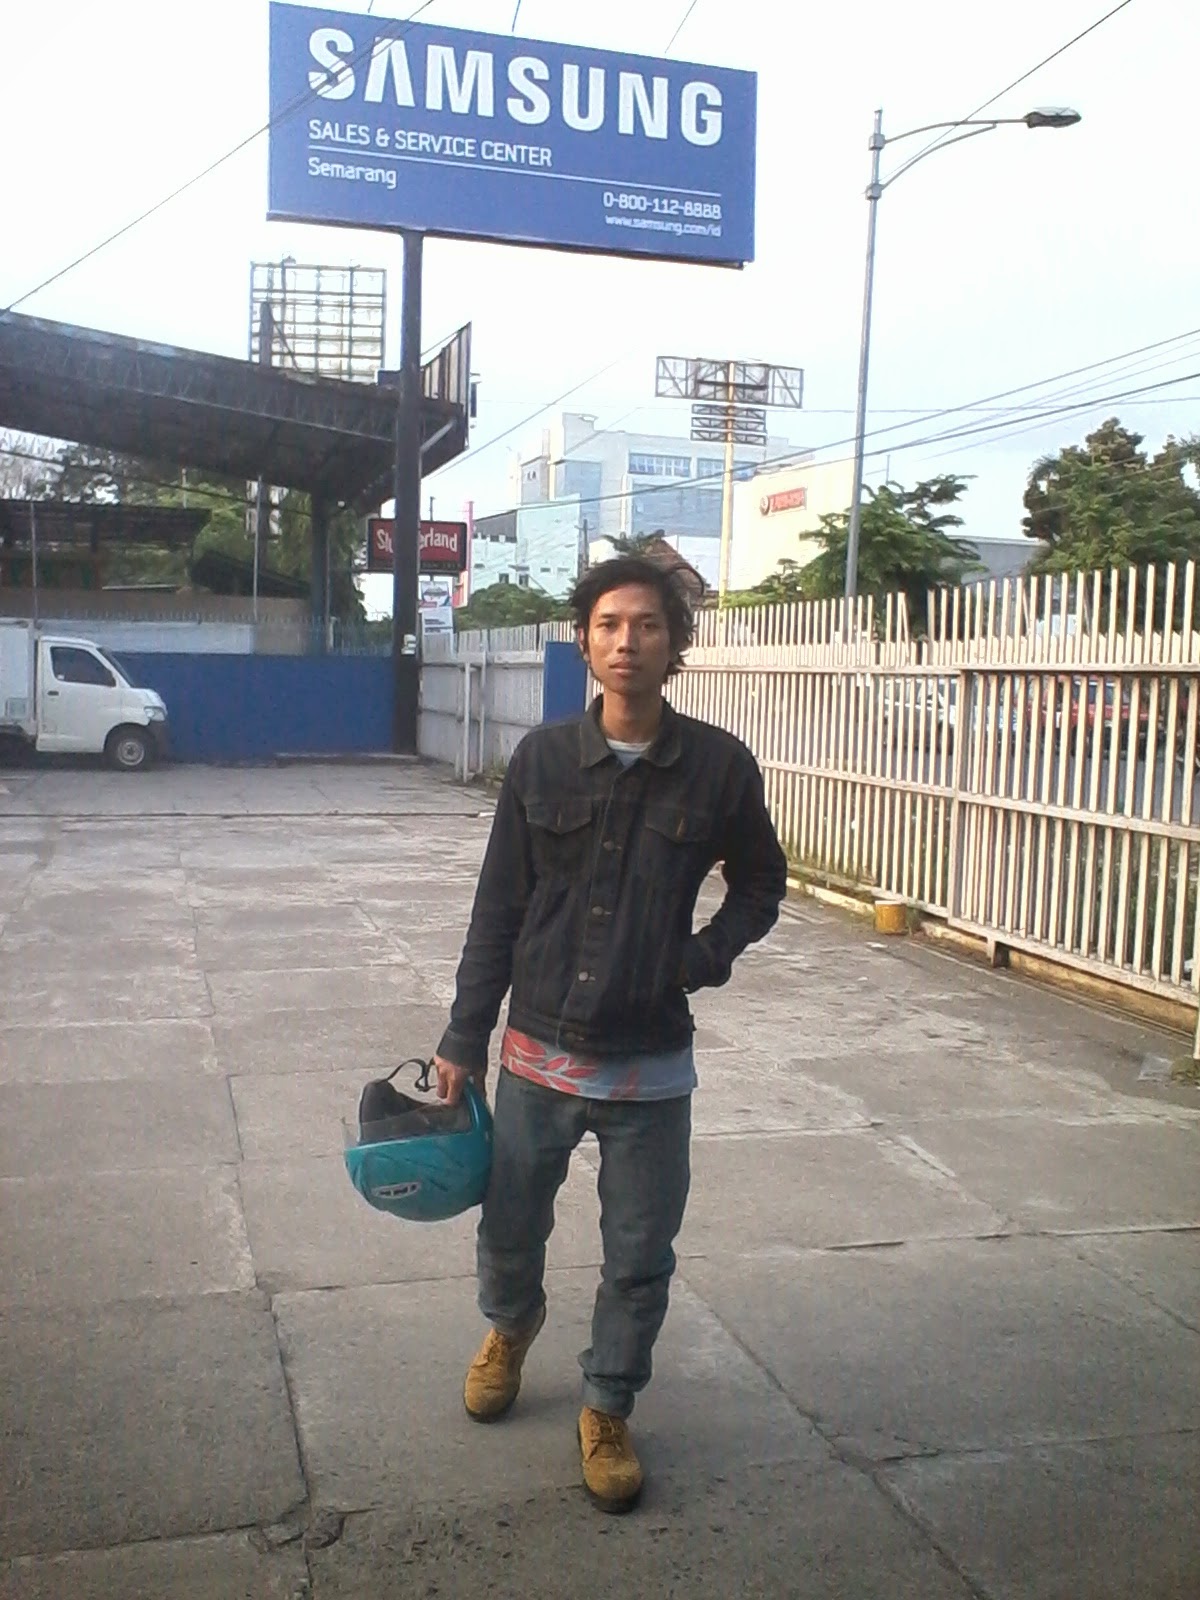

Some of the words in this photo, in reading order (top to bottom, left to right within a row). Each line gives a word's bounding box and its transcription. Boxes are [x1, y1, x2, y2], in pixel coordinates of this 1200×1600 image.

[308, 28, 724, 147] SAMSUNG
[309, 119, 371, 146] SALES
[376, 127, 390, 147] &
[395, 130, 477, 158] SERVICE
[481, 140, 553, 167] CENTER
[308, 157, 397, 189] Semarang
[603, 192, 722, 220] 0-800-112-8888
